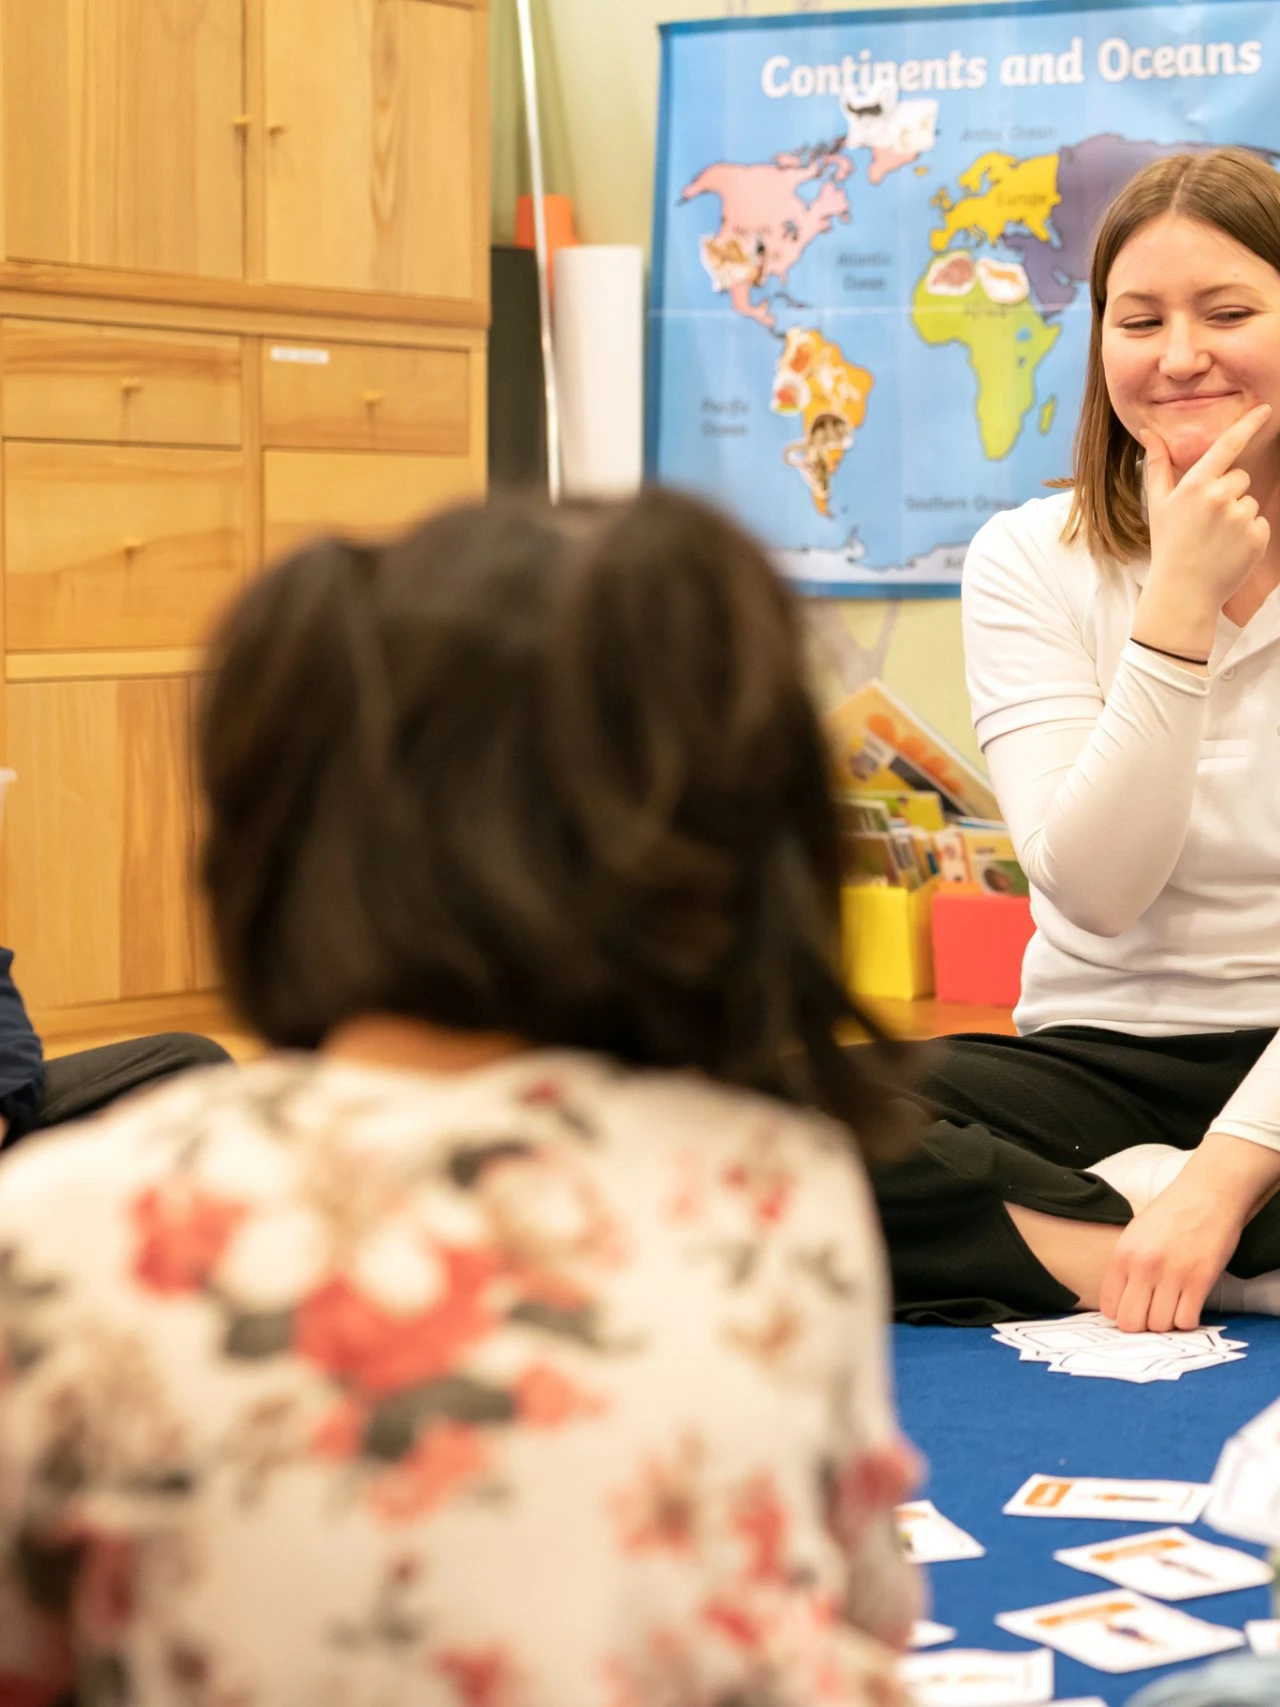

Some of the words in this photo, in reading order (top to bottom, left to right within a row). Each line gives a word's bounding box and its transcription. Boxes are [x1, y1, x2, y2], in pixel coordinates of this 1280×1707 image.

[760, 49, 988, 98] Continents
[1000, 37, 1084, 87] and
[1098, 38, 1262, 83] Oceans
[1009, 126, 1056, 140] Ocean
[996, 191, 1048, 209] Europe
[837, 252, 892, 268] Atlantic
[842, 275, 887, 291] Ocean
[701, 419, 748, 438] Ocean
[905, 493, 969, 512] Southern
